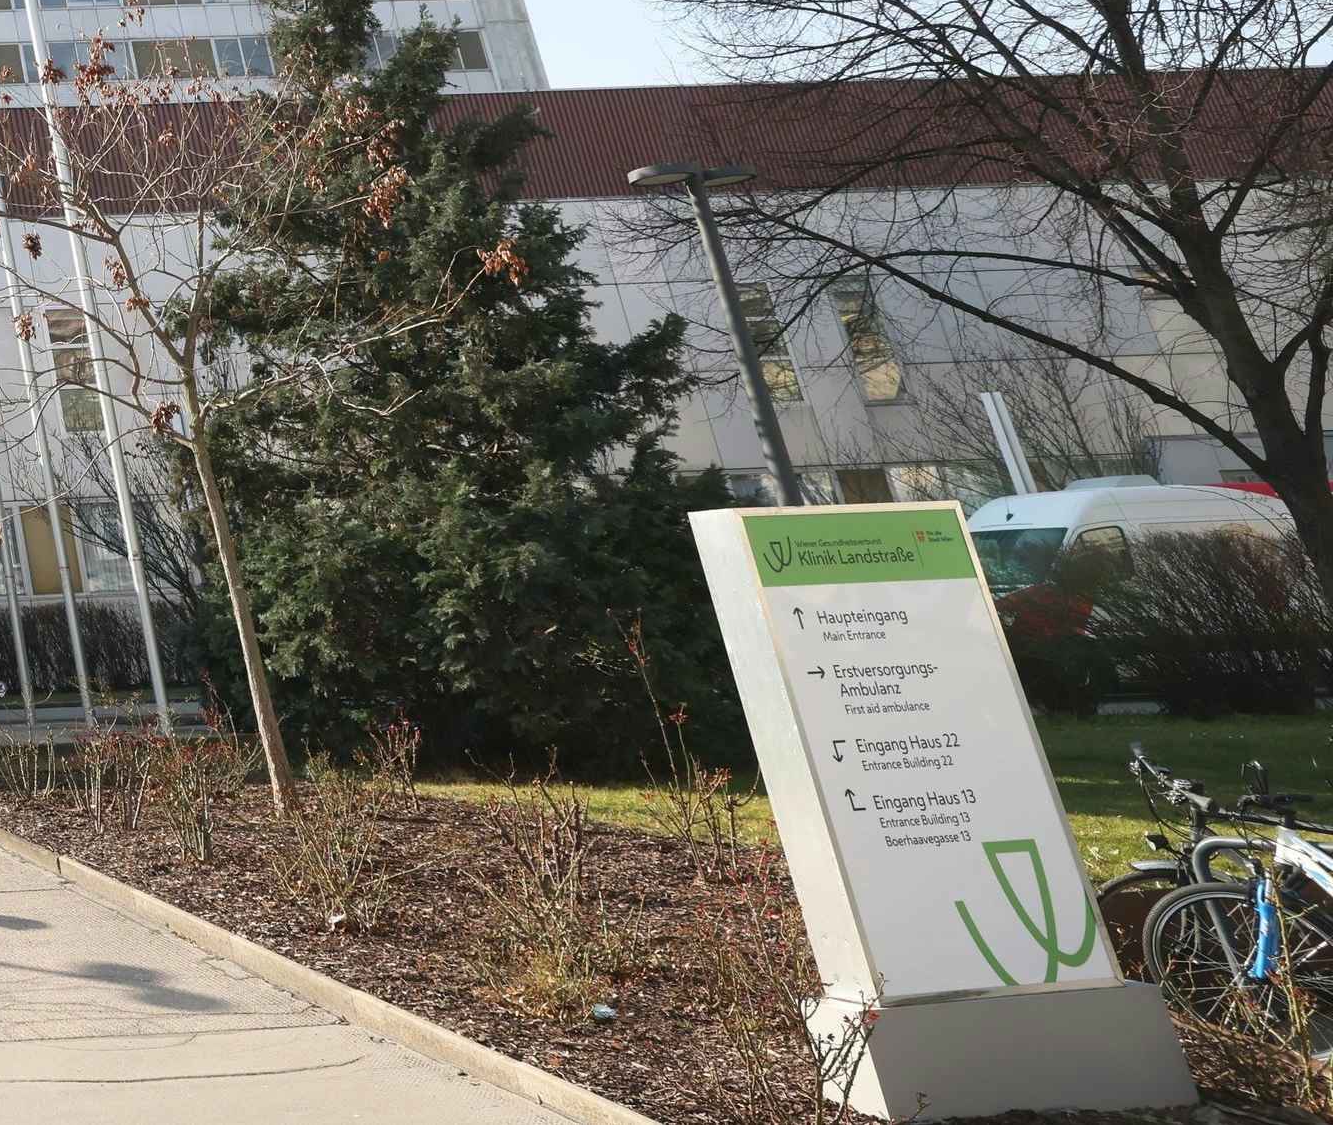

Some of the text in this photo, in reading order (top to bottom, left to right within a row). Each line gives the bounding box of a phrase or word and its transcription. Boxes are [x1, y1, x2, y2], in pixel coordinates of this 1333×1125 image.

[794, 537, 882, 548] Wiener Gesundheitsverbund
[798, 546, 915, 567] Klinik Landstraße
[816, 608, 909, 628] Haupteingang
[823, 629, 886, 642] Main Entrance
[833, 662, 939, 680] Erstversorgungs-
[840, 681, 902, 698] Ambulanz
[844, 701, 931, 715] First aid ambulance
[855, 733, 961, 756] Eingang Haus 22
[861, 755, 954, 772] Entrance Building 22
[873, 789, 977, 813] Eingang Haus 13
[879, 812, 971, 829] Entrance Building 13
[885, 831, 972, 848] Boerhaavegasse 13
